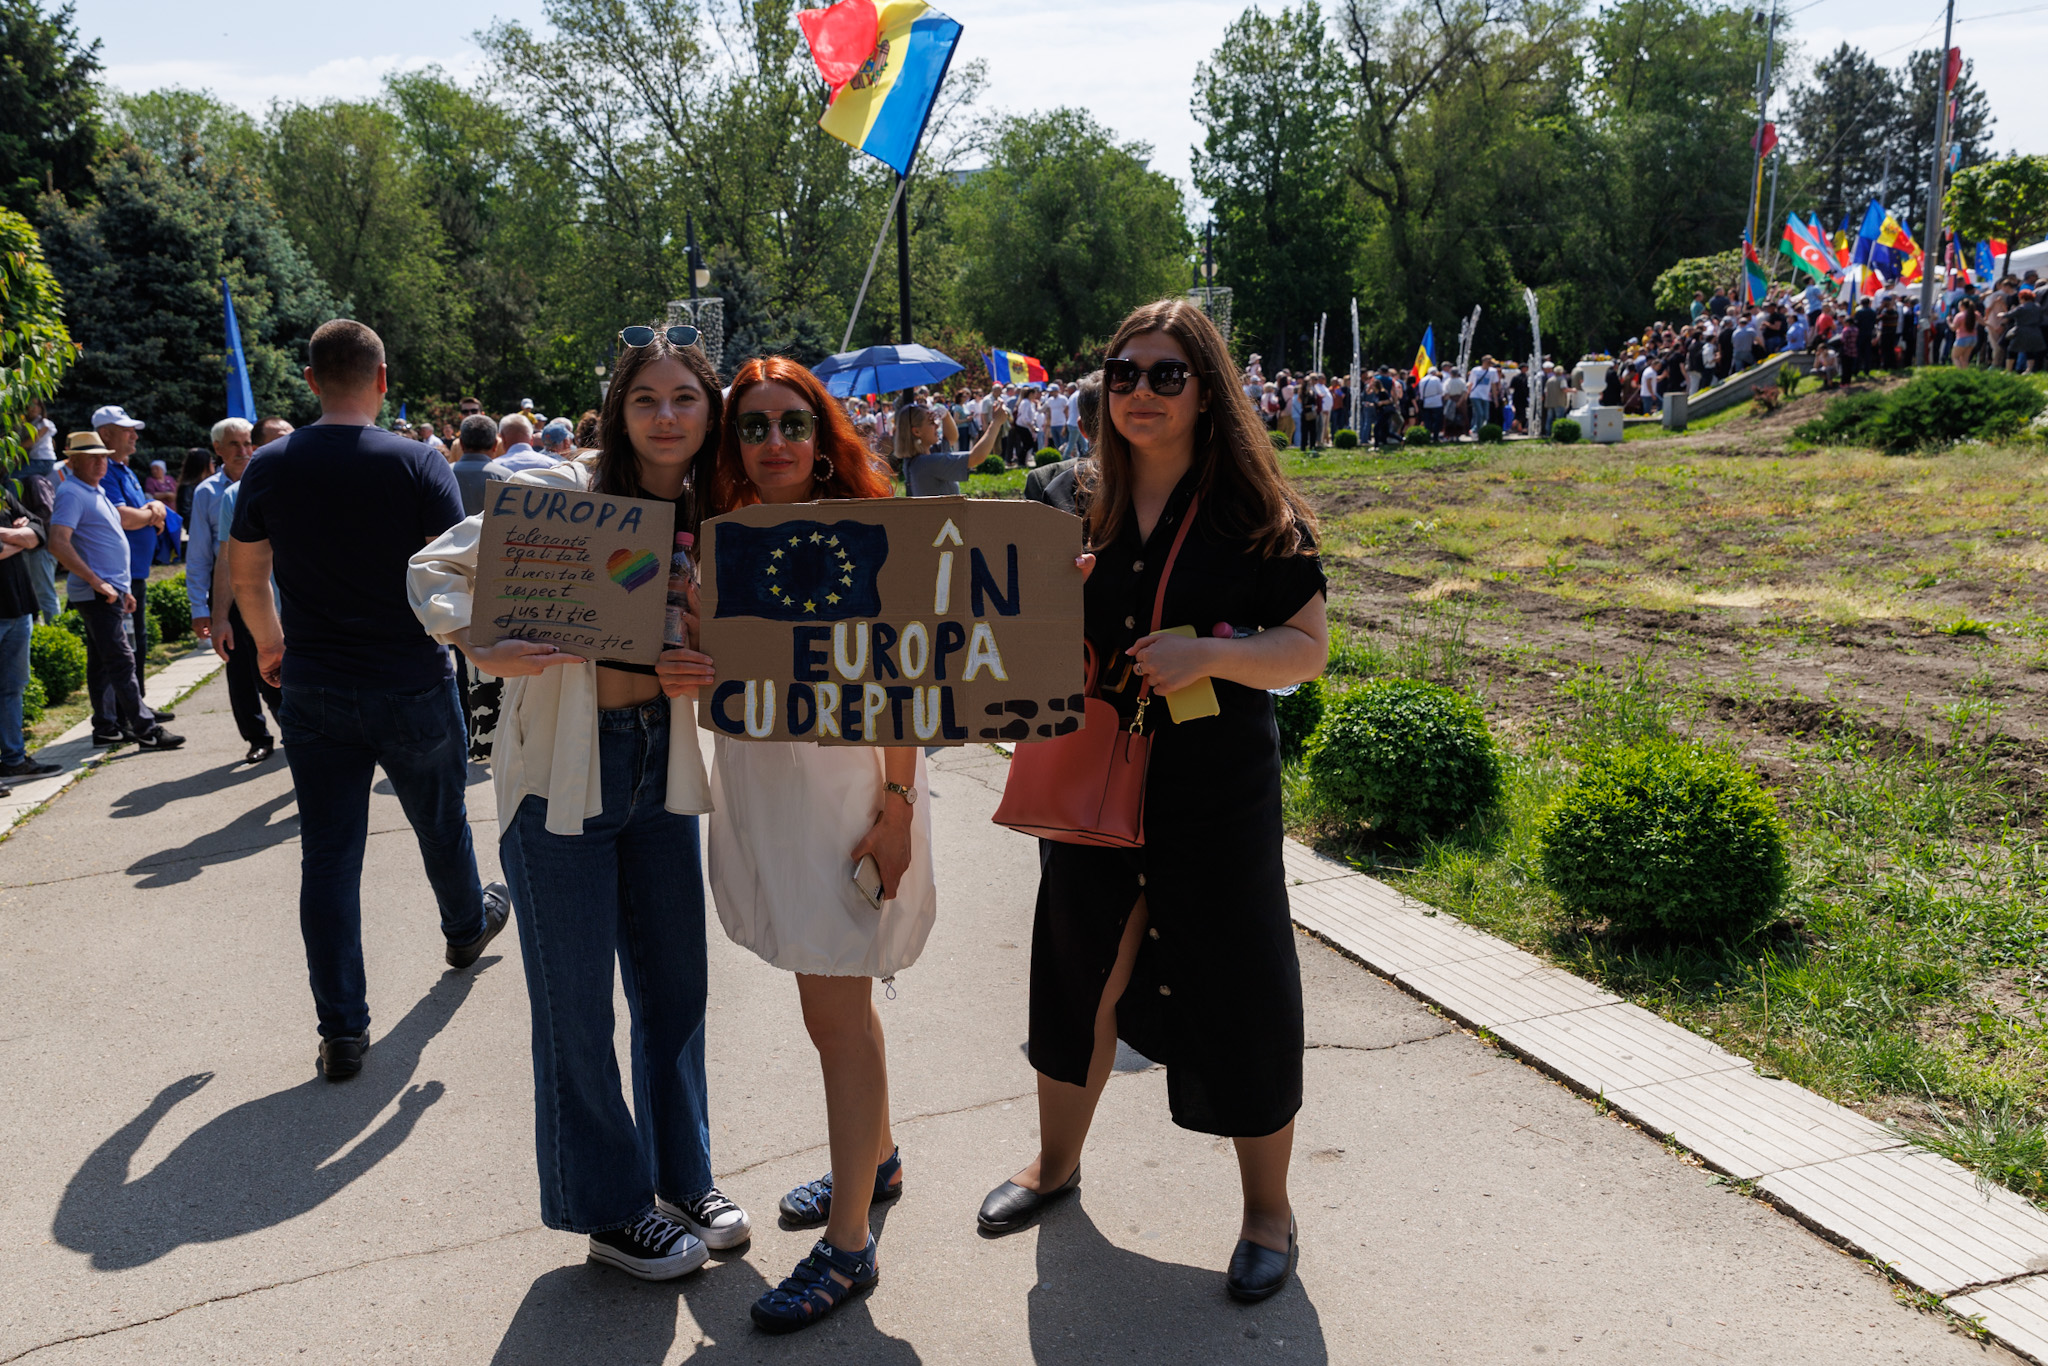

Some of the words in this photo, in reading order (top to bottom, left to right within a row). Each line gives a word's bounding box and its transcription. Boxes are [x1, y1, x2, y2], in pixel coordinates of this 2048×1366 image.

[492, 486, 643, 534] EUROPA
[506, 546, 591, 564] egalitate
[932, 518, 1020, 616] ÎN
[505, 565, 595, 580] diversitate
[504, 584, 576, 602] respect
[793, 621, 1008, 681] EUROPA
[710, 679, 777, 738] CU
[786, 681, 969, 742] DREPTUL
[814, 1241, 833, 1257] FILA
